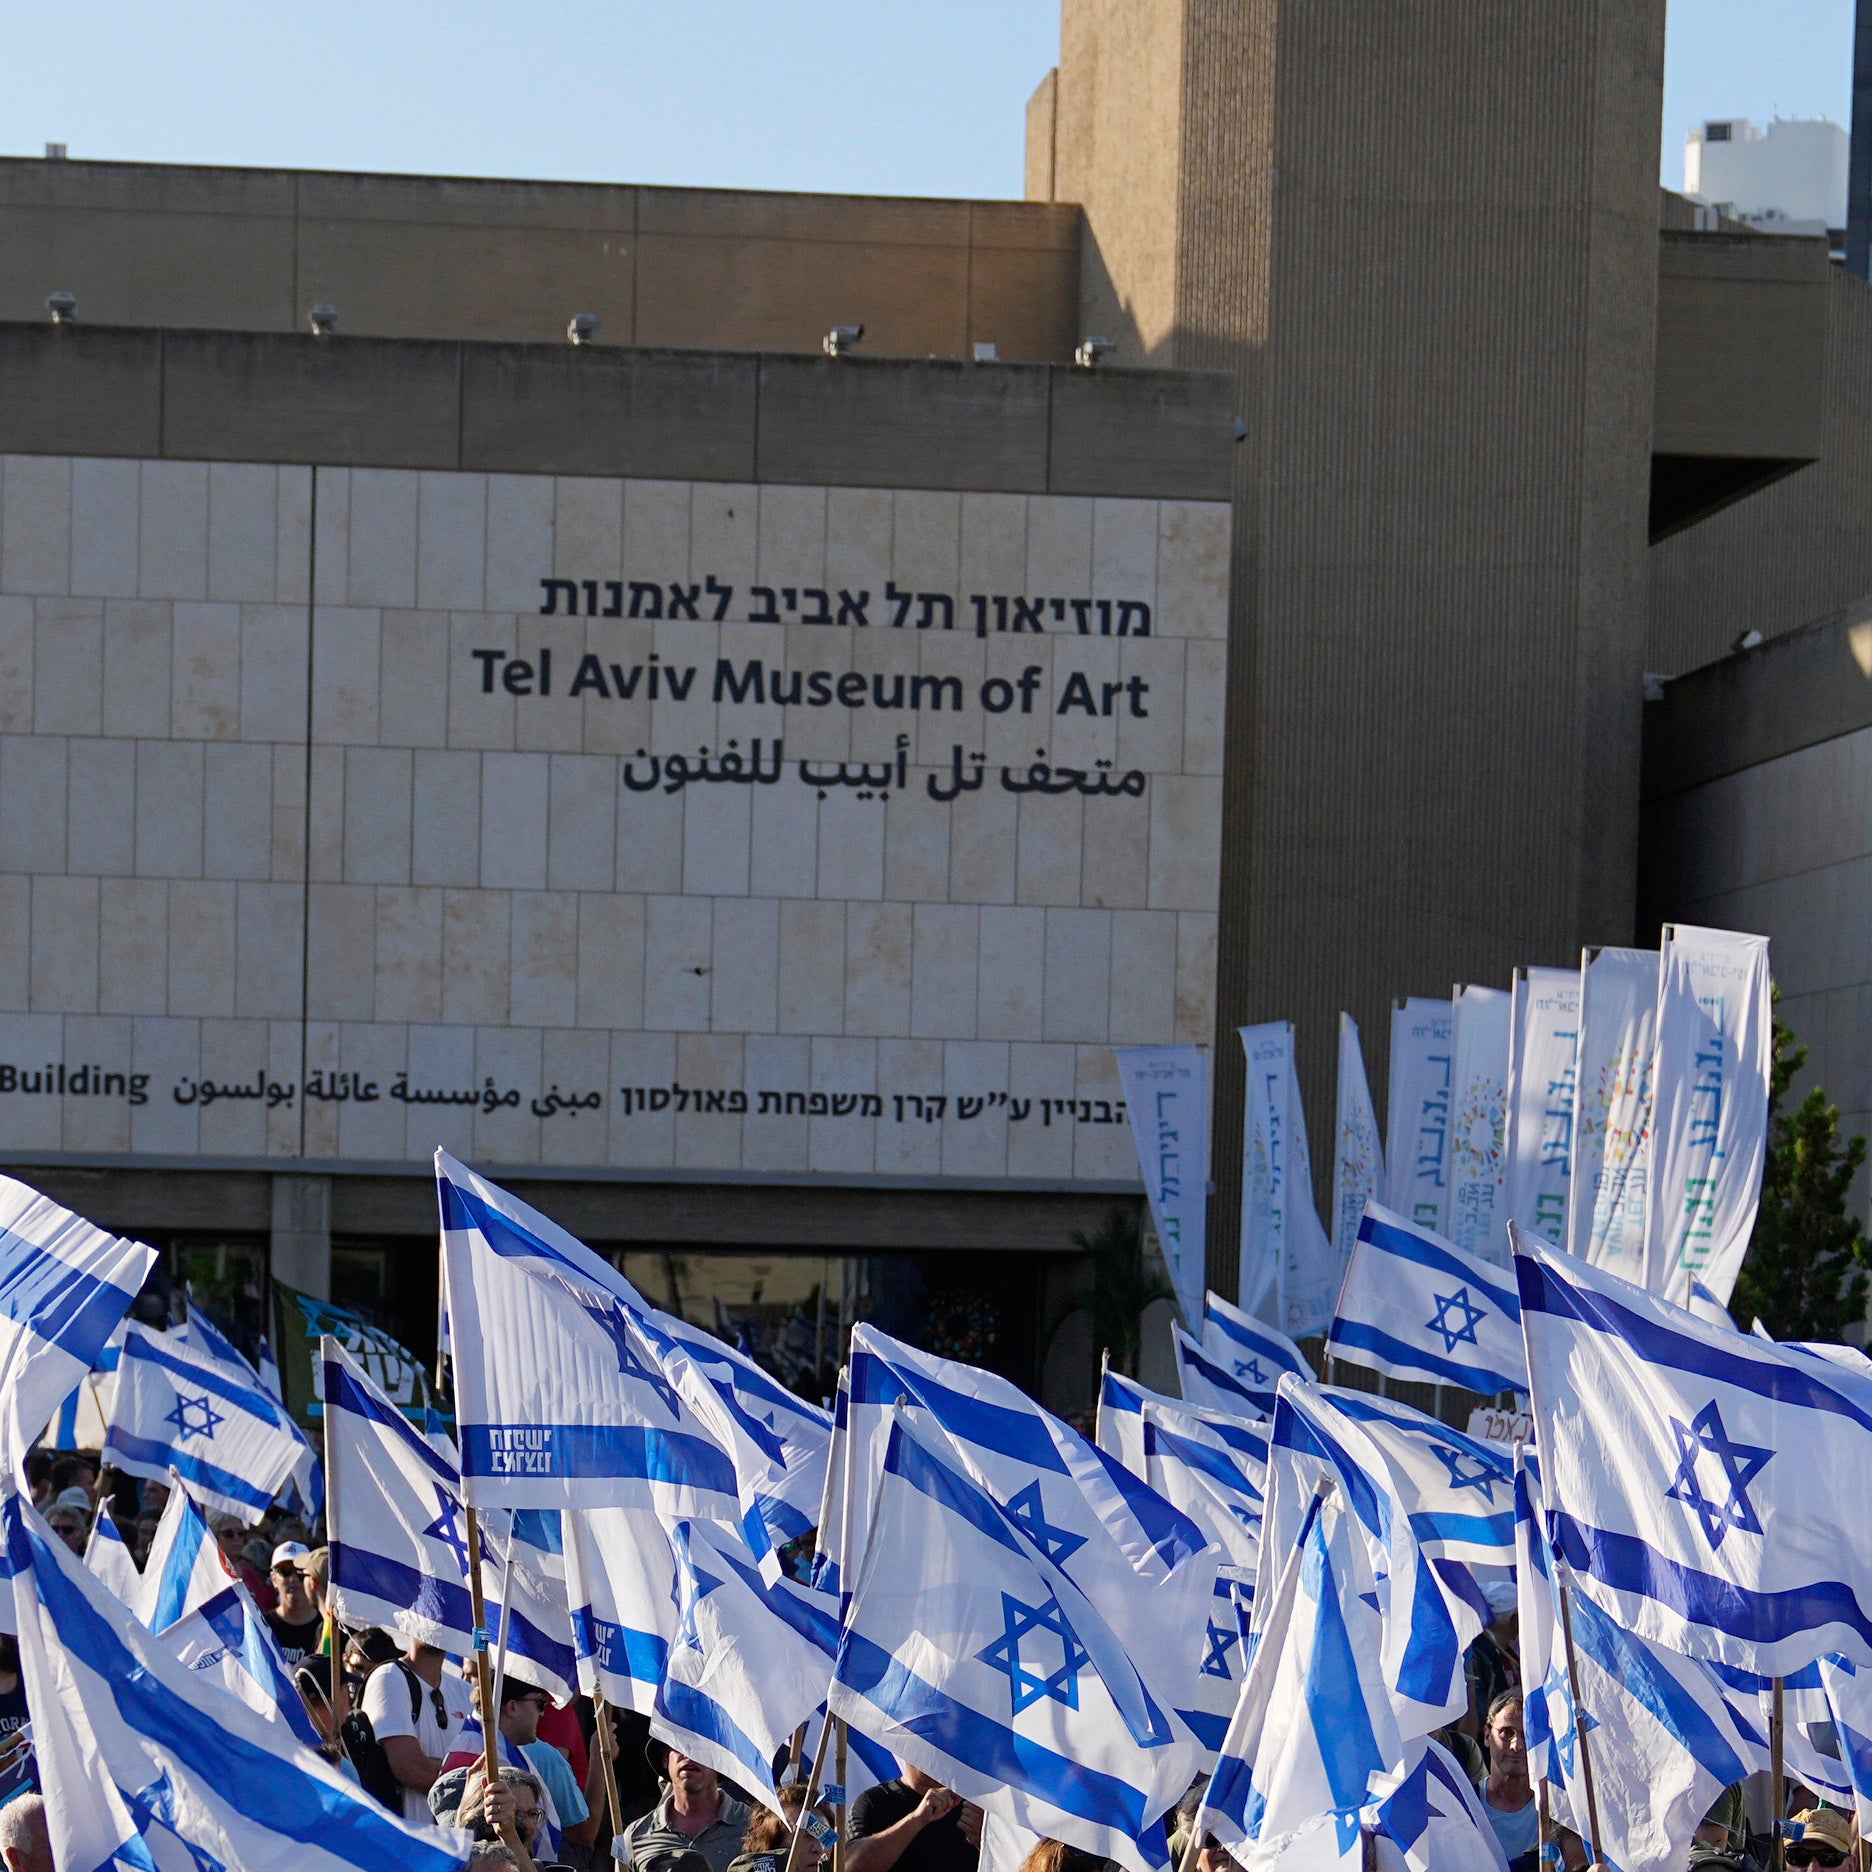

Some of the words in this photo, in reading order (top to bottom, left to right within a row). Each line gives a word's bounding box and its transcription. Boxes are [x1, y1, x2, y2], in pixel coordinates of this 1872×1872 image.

[540, 575, 732, 621] לאמנות
[749, 586, 869, 627] אביב
[886, 582, 954, 630] תל
[971, 595, 1150, 638] מוזיאון
[472, 649, 551, 696] Tel
[569, 654, 696, 700] Aviv
[713, 659, 962, 711] Museum
[980, 666, 1042, 713] of
[1057, 672, 1148, 718] Art
[624, 739, 783, 794] للفنون
[800, 734, 909, 802] أبيب
[927, 745, 986, 802] تل
[1001, 751, 1145, 797] متحف
[174, 1070, 295, 1108] بولسون
[390, 1073, 520, 1114] مؤسسة
[531, 1086, 601, 1118] مبنى
[621, 1083, 747, 1115] פאולסון
[758, 1092, 882, 1117] משפחת
[893, 1095, 947, 1123] קרן
